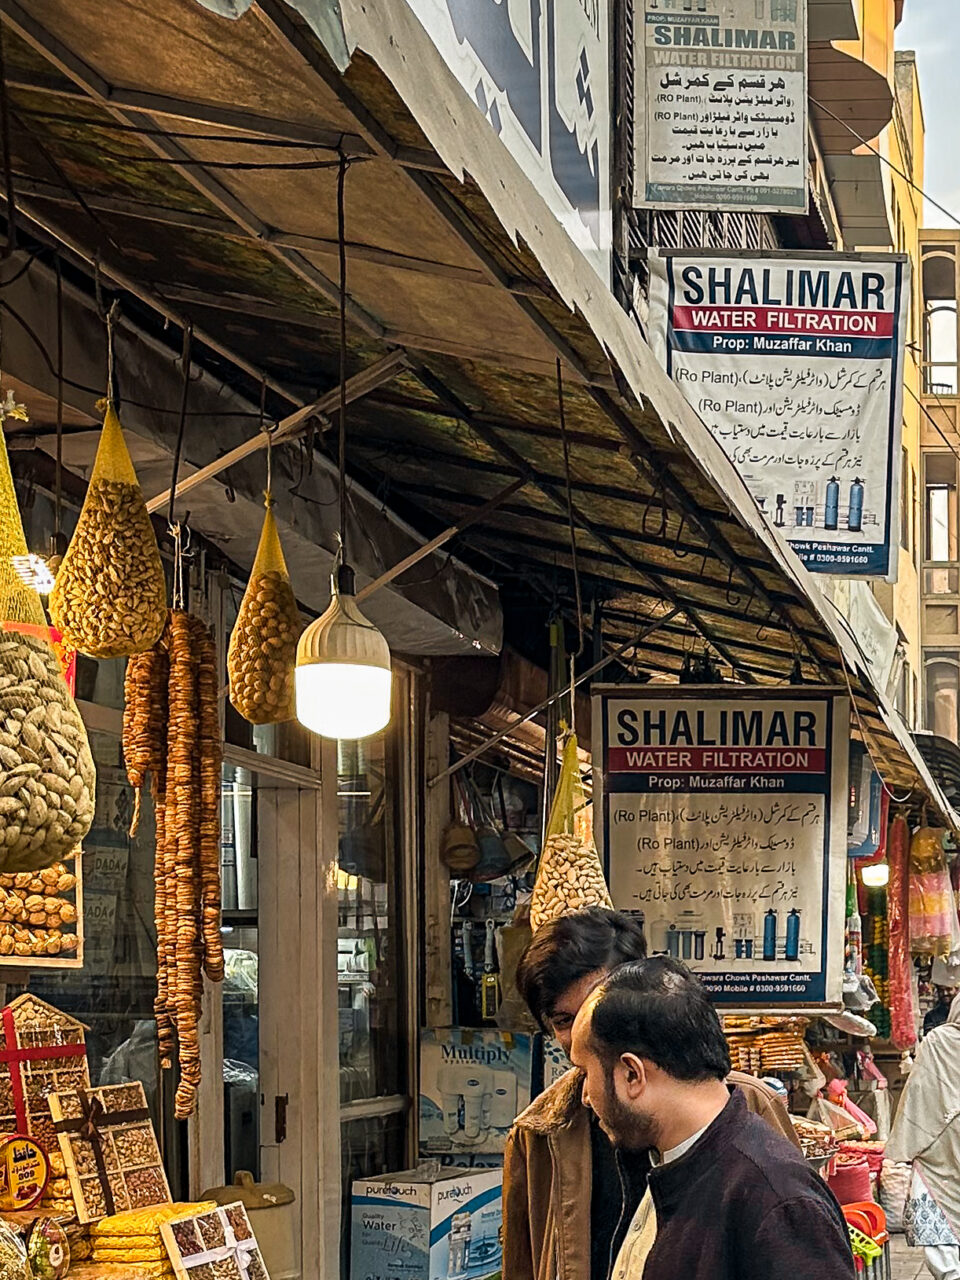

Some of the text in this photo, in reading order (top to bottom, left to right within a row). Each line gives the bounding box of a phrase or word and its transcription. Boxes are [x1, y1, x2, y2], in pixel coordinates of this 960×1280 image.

[654, 26, 796, 50] SHALIMAR
[653, 51, 796, 70] WATER FILTRATION
[681, 266, 886, 311] SHALIMAR
[692, 310, 877, 332] WATER FILTRATION
[713, 336, 852, 353] Prop: Muzaffar Khan
[812, 543, 851, 553] Peshawar
[617, 709, 817, 747] SHALIMAR
[627, 752, 808, 768] WATER FILTRATION
[649, 775, 785, 790] Prop: Muzaffar Khan
[724, 973, 750, 982] Chowk
[751, 974, 789, 982] Peshawar
[723, 985, 749, 993] Mobile
[441, 1044, 511, 1065] Multiply
[366, 1186, 417, 1198] puretouch
[362, 1220, 397, 1231] Water
